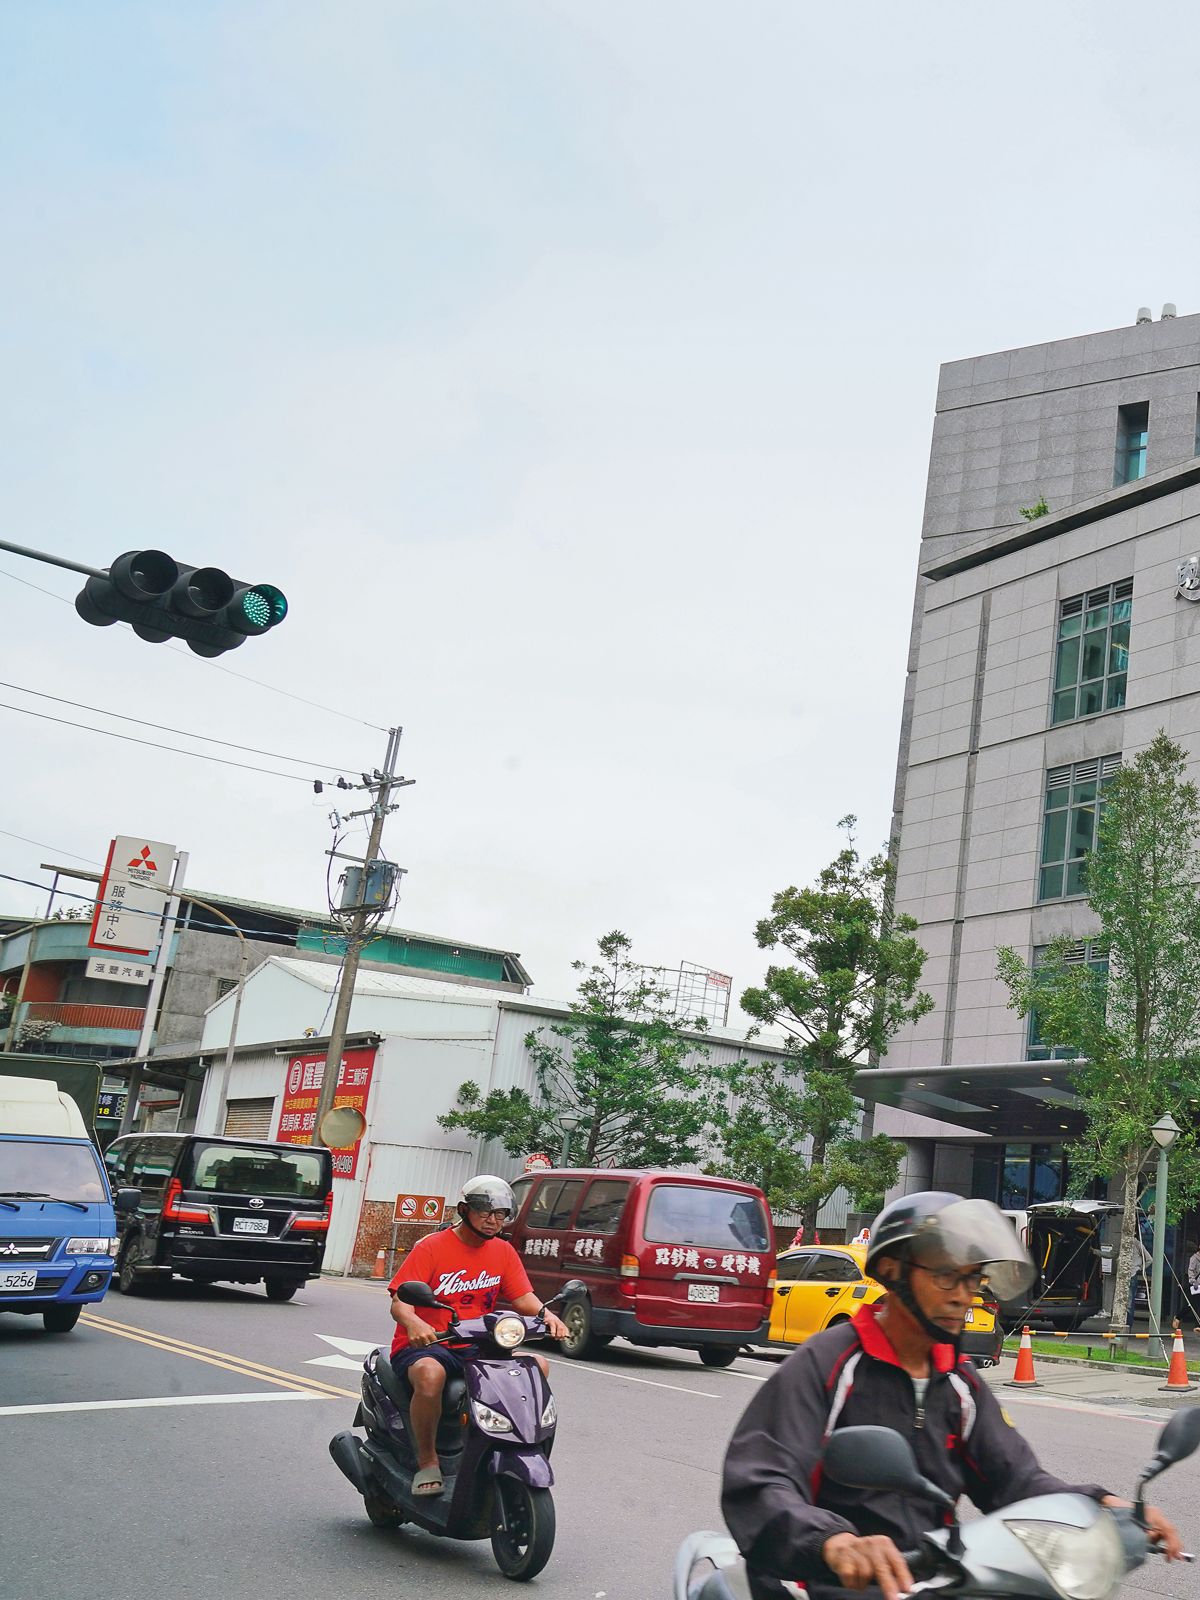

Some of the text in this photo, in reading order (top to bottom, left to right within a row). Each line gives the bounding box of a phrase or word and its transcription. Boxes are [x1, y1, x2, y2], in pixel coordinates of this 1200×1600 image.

[102, 885, 126, 940] 服務中心
[655, 1247, 701, 1269] 點鈔機
[433, 1269, 501, 1296] Hiroshima
